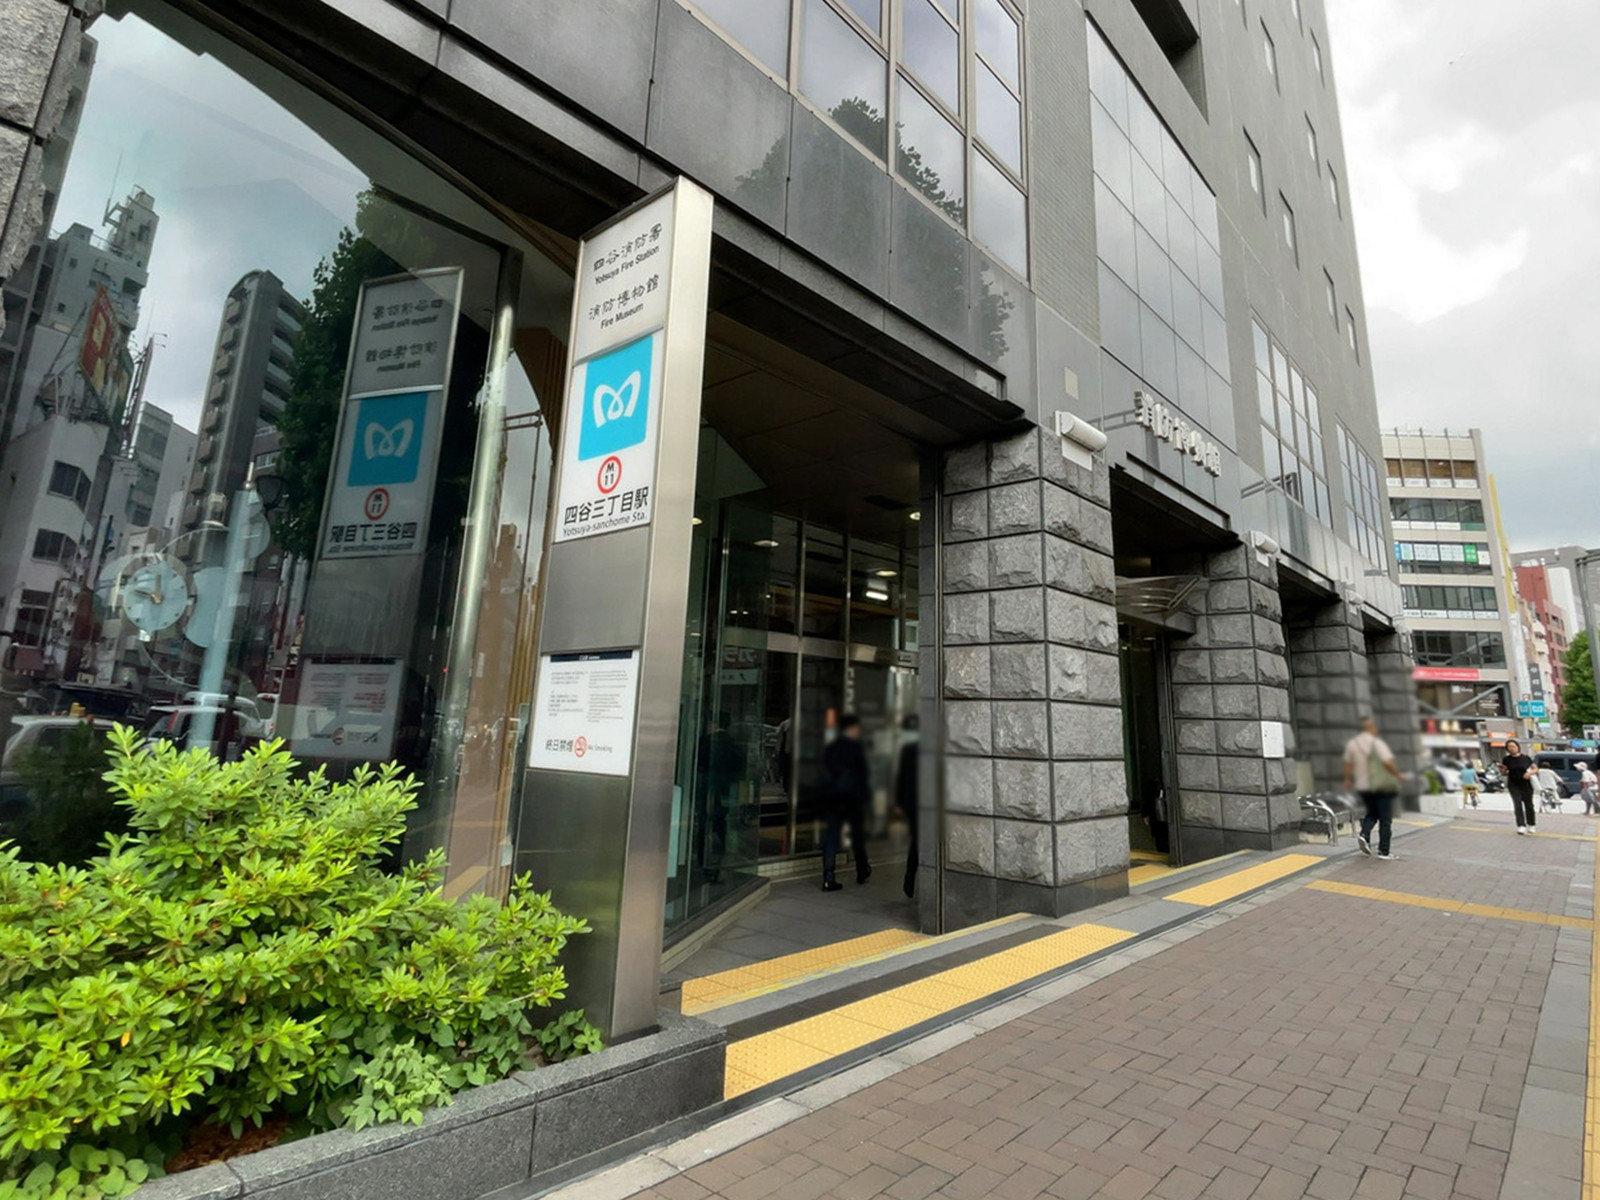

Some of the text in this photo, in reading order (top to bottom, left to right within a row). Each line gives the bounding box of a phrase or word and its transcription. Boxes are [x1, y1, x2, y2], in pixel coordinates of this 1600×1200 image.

[595, 245, 660, 285] Yotsuya Fire Station
[588, 273, 660, 320] 消防博物館
[600, 303, 644, 329] Fire Museum
[604, 473, 614, 486] 11
[606, 462, 614, 473] M
[564, 486, 649, 525] 四谷三丁目駅
[562, 511, 647, 536] Yotsuya-sanchome Sta.
